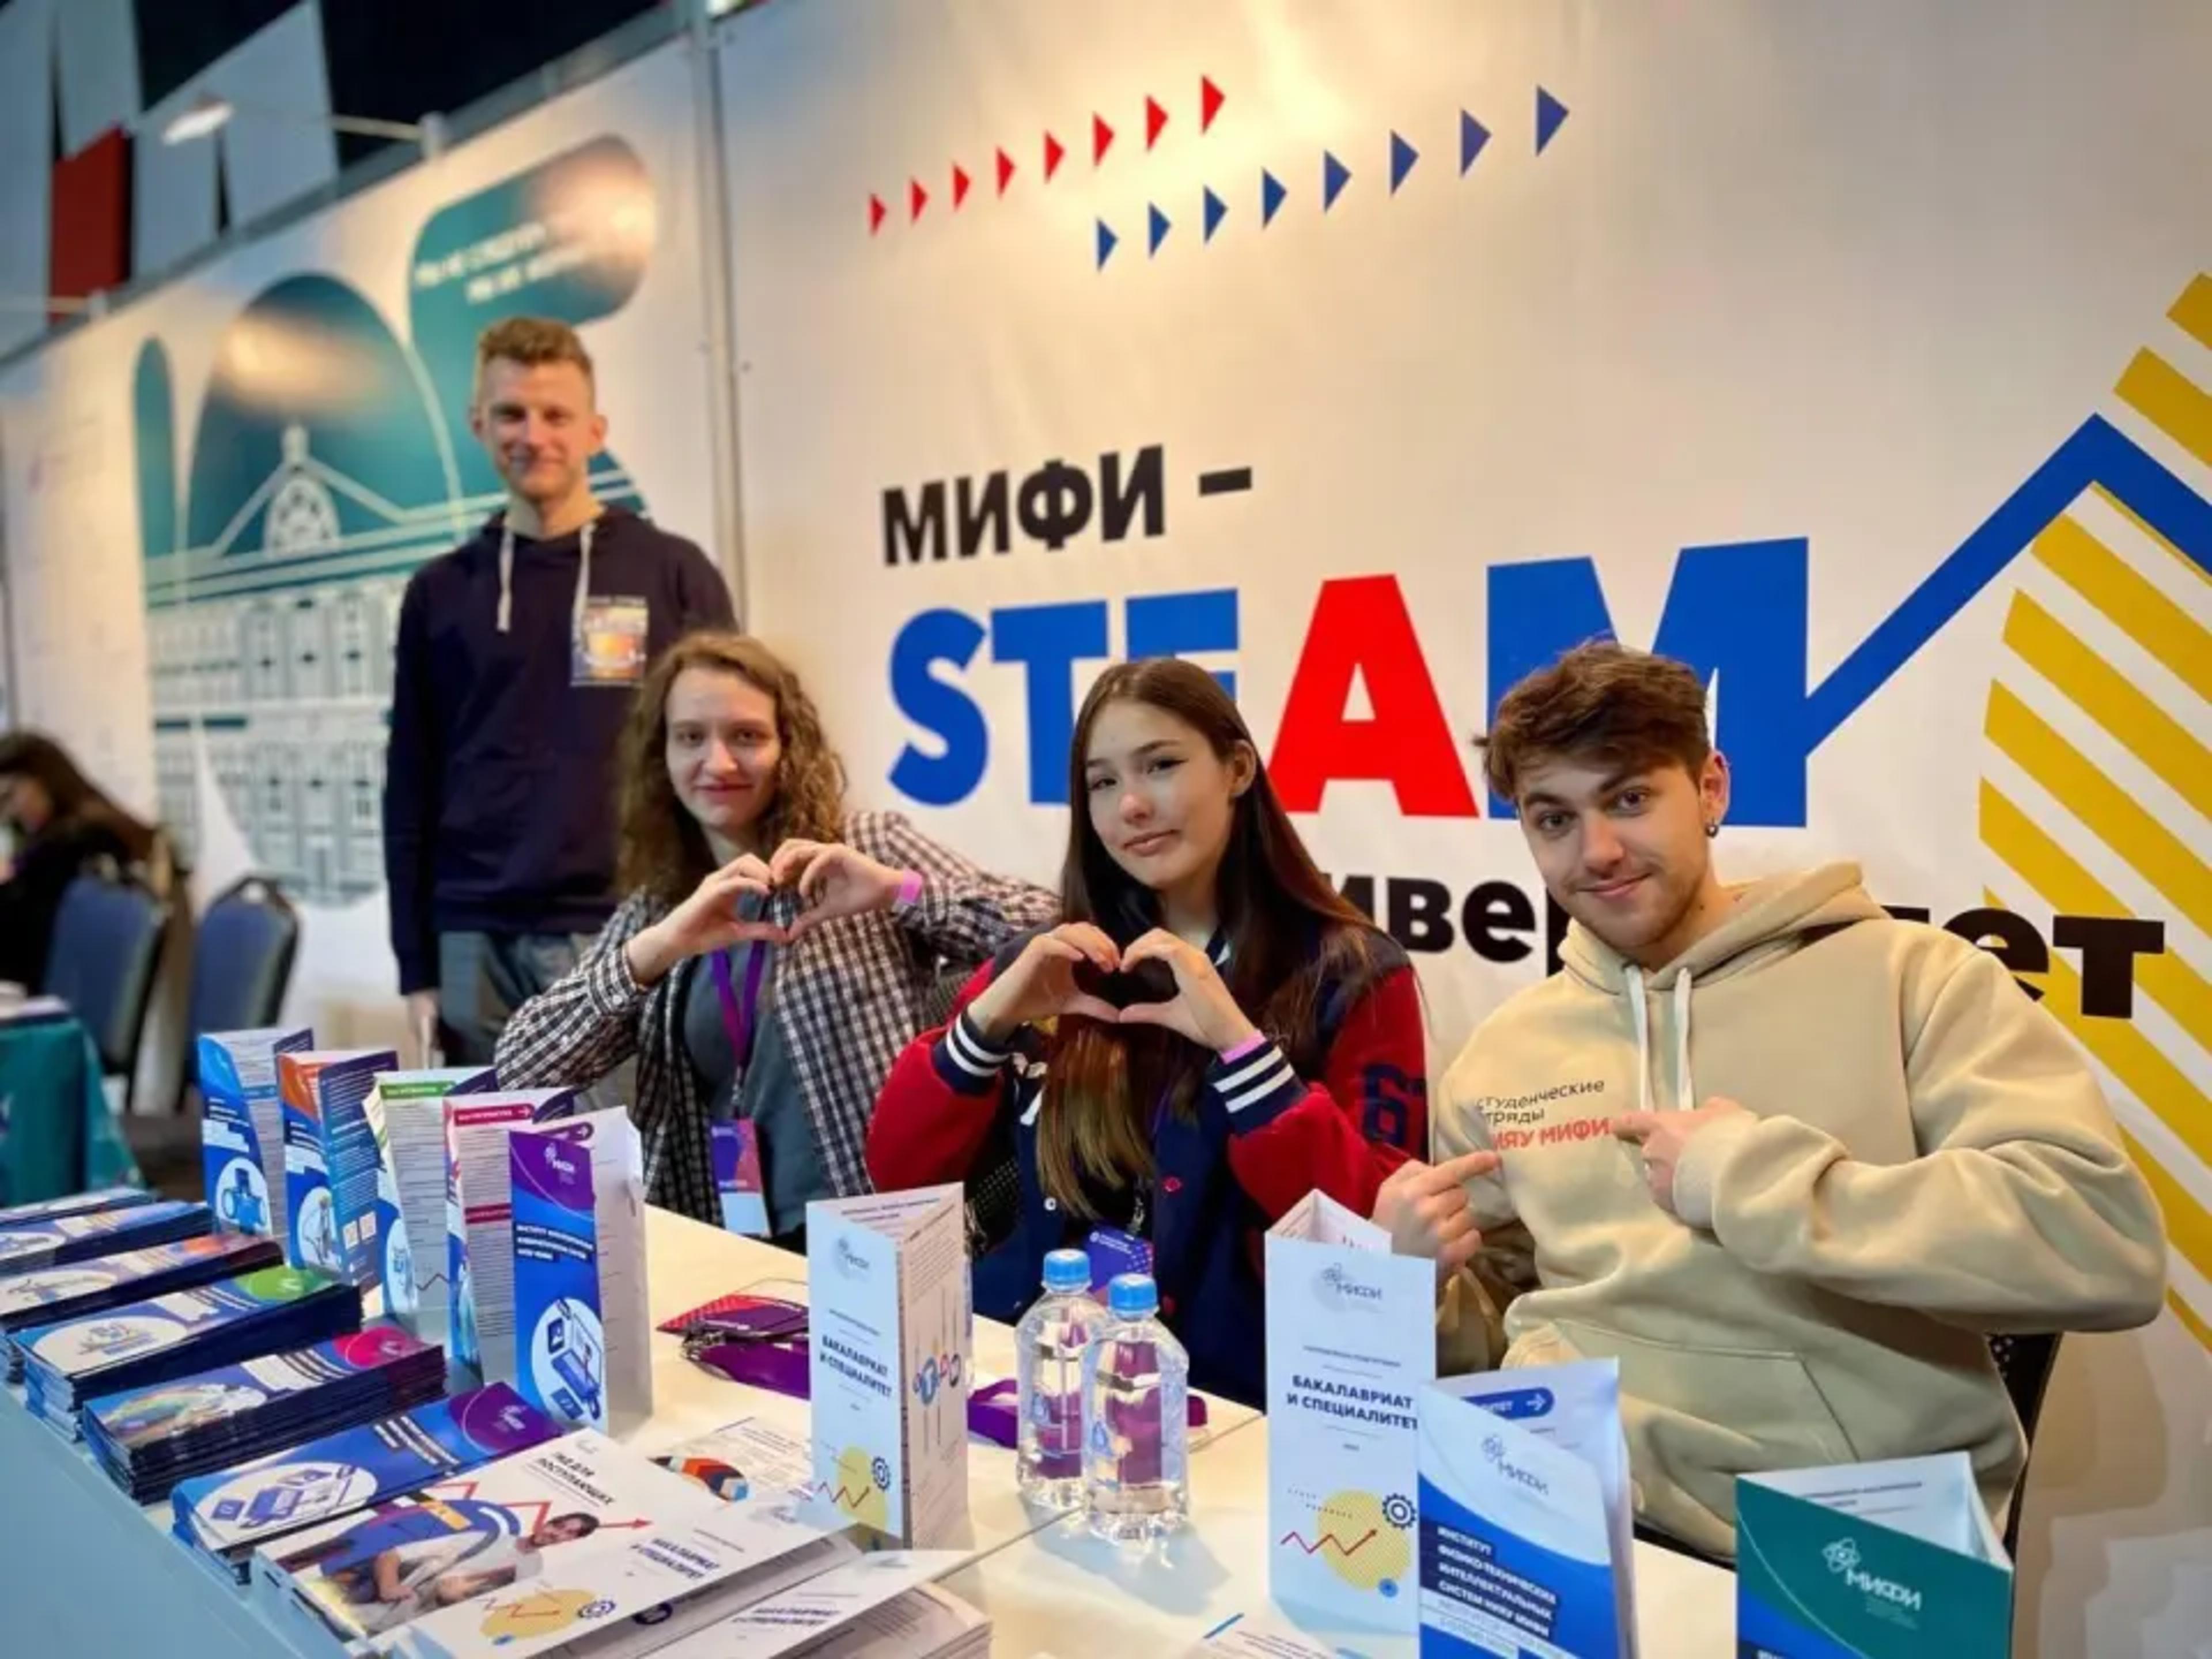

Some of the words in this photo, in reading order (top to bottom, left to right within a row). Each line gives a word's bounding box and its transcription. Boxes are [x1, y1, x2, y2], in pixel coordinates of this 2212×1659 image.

[882, 444, 1164, 567] МИФИ
[1484, 1109, 1544, 1125] тряды
[1540, 1117, 1610, 1145] МИФИ
[1287, 1391, 1298, 1406] И
[1292, 1374, 1413, 1409] БАКАЛАВРИАТ
[1847, 1569, 1922, 1611] МИФИ
